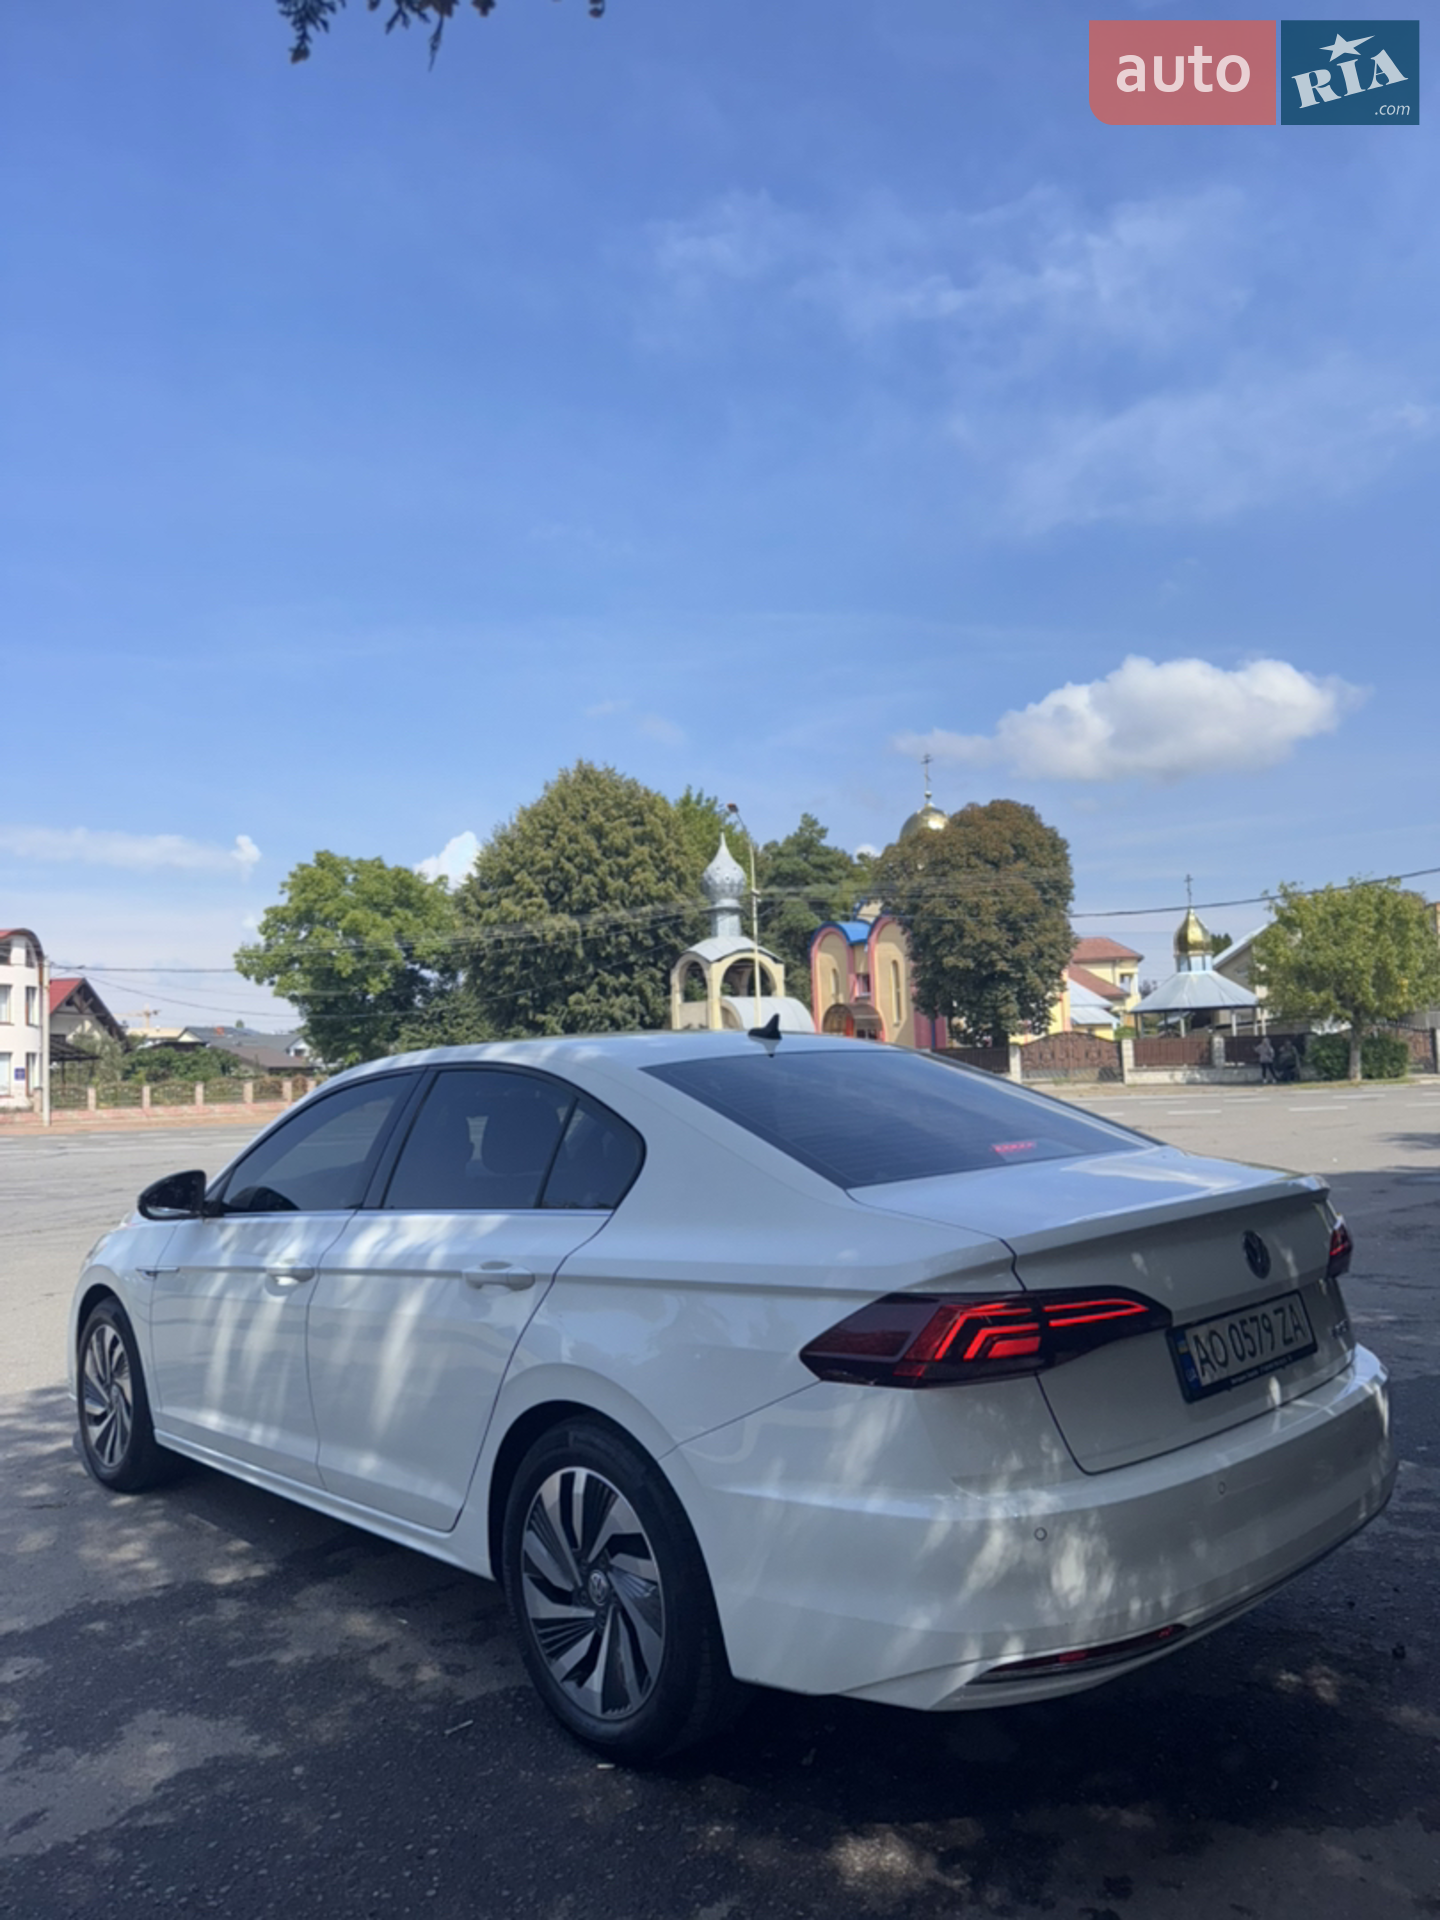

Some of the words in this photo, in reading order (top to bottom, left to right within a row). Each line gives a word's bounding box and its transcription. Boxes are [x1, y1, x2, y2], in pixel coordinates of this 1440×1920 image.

[1192, 1330, 1229, 1377] AO
[1228, 1313, 1276, 1363] 0579
[1273, 1303, 1306, 1346] ZA
